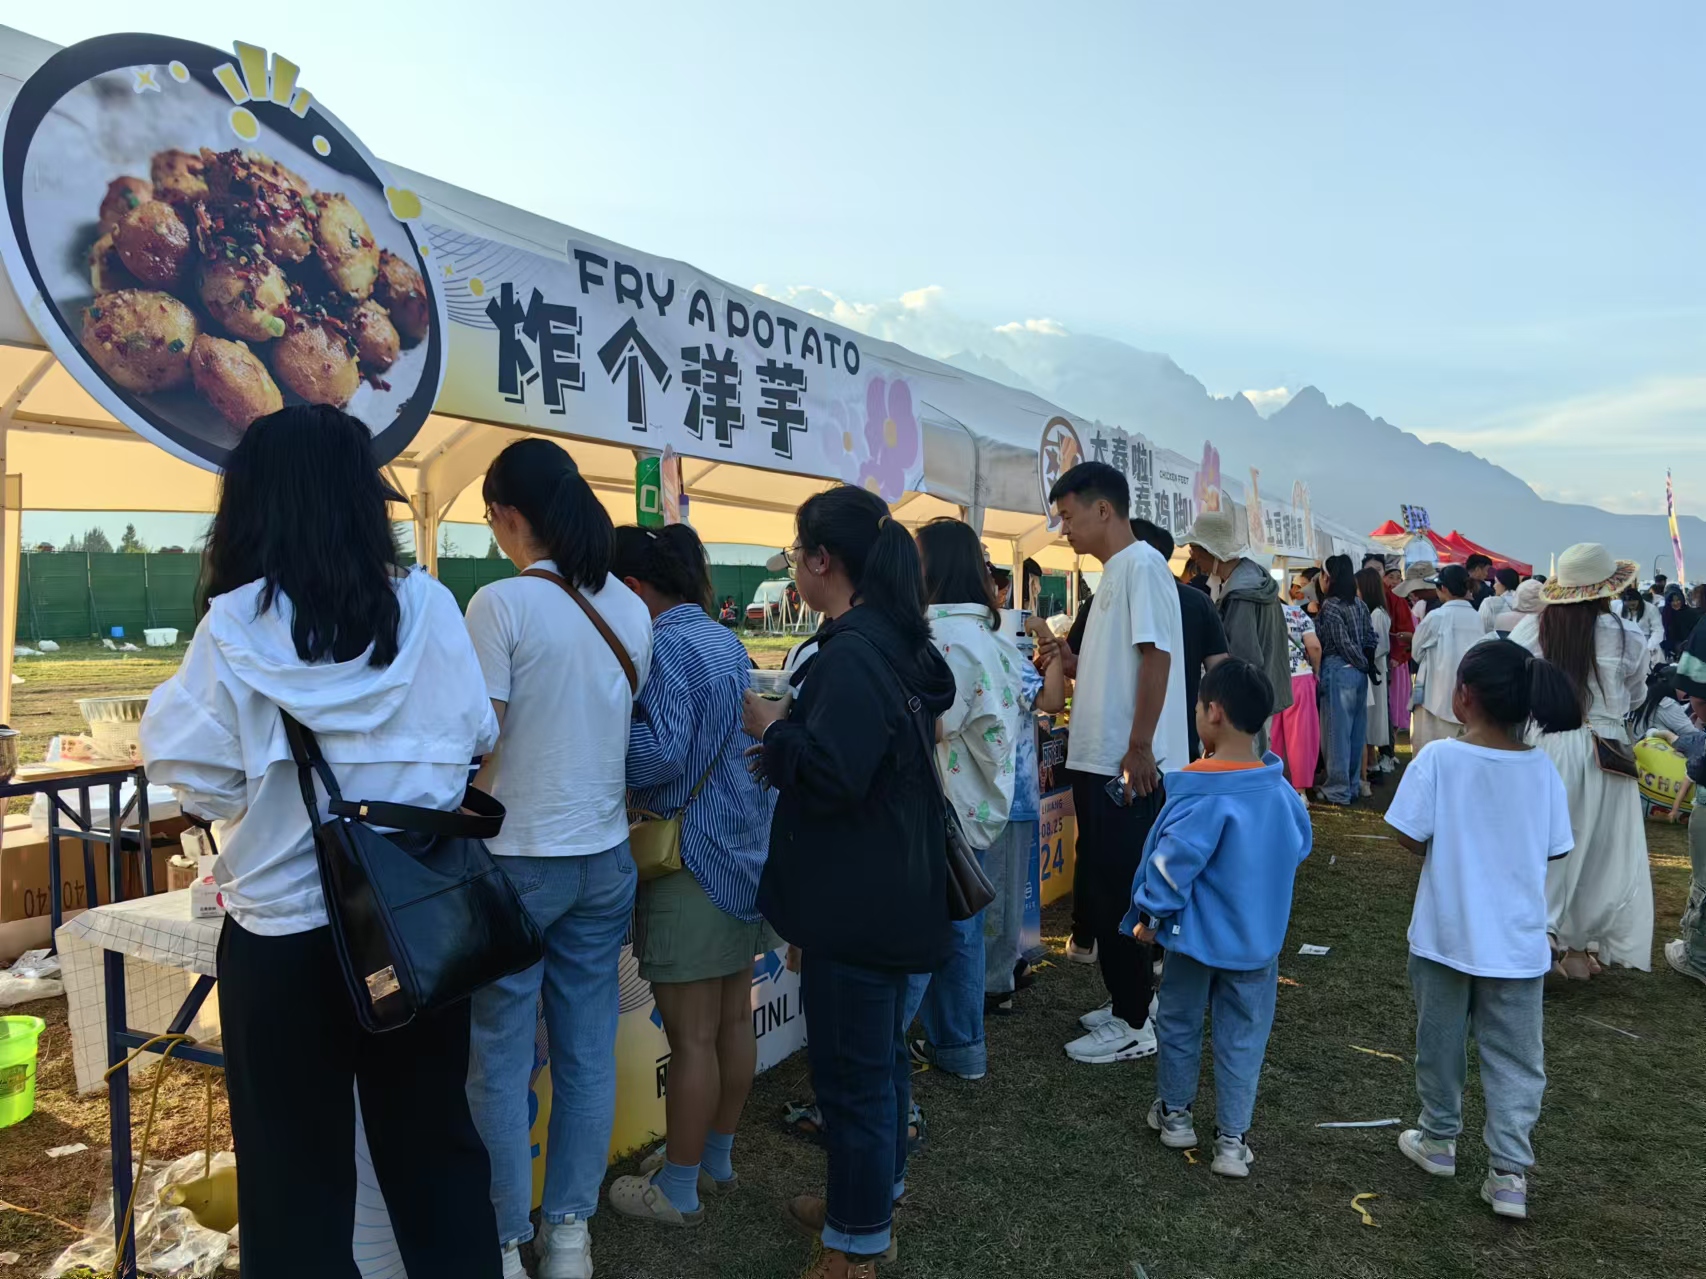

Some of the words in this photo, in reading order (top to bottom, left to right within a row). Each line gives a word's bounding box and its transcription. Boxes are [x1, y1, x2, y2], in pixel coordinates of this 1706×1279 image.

[485, 282, 808, 459] 炸个洋芋
[573, 248, 675, 317] FRY
[688, 289, 715, 333] A
[727, 299, 861, 376] POTATO
[1178, 474, 1190, 485] FEET
